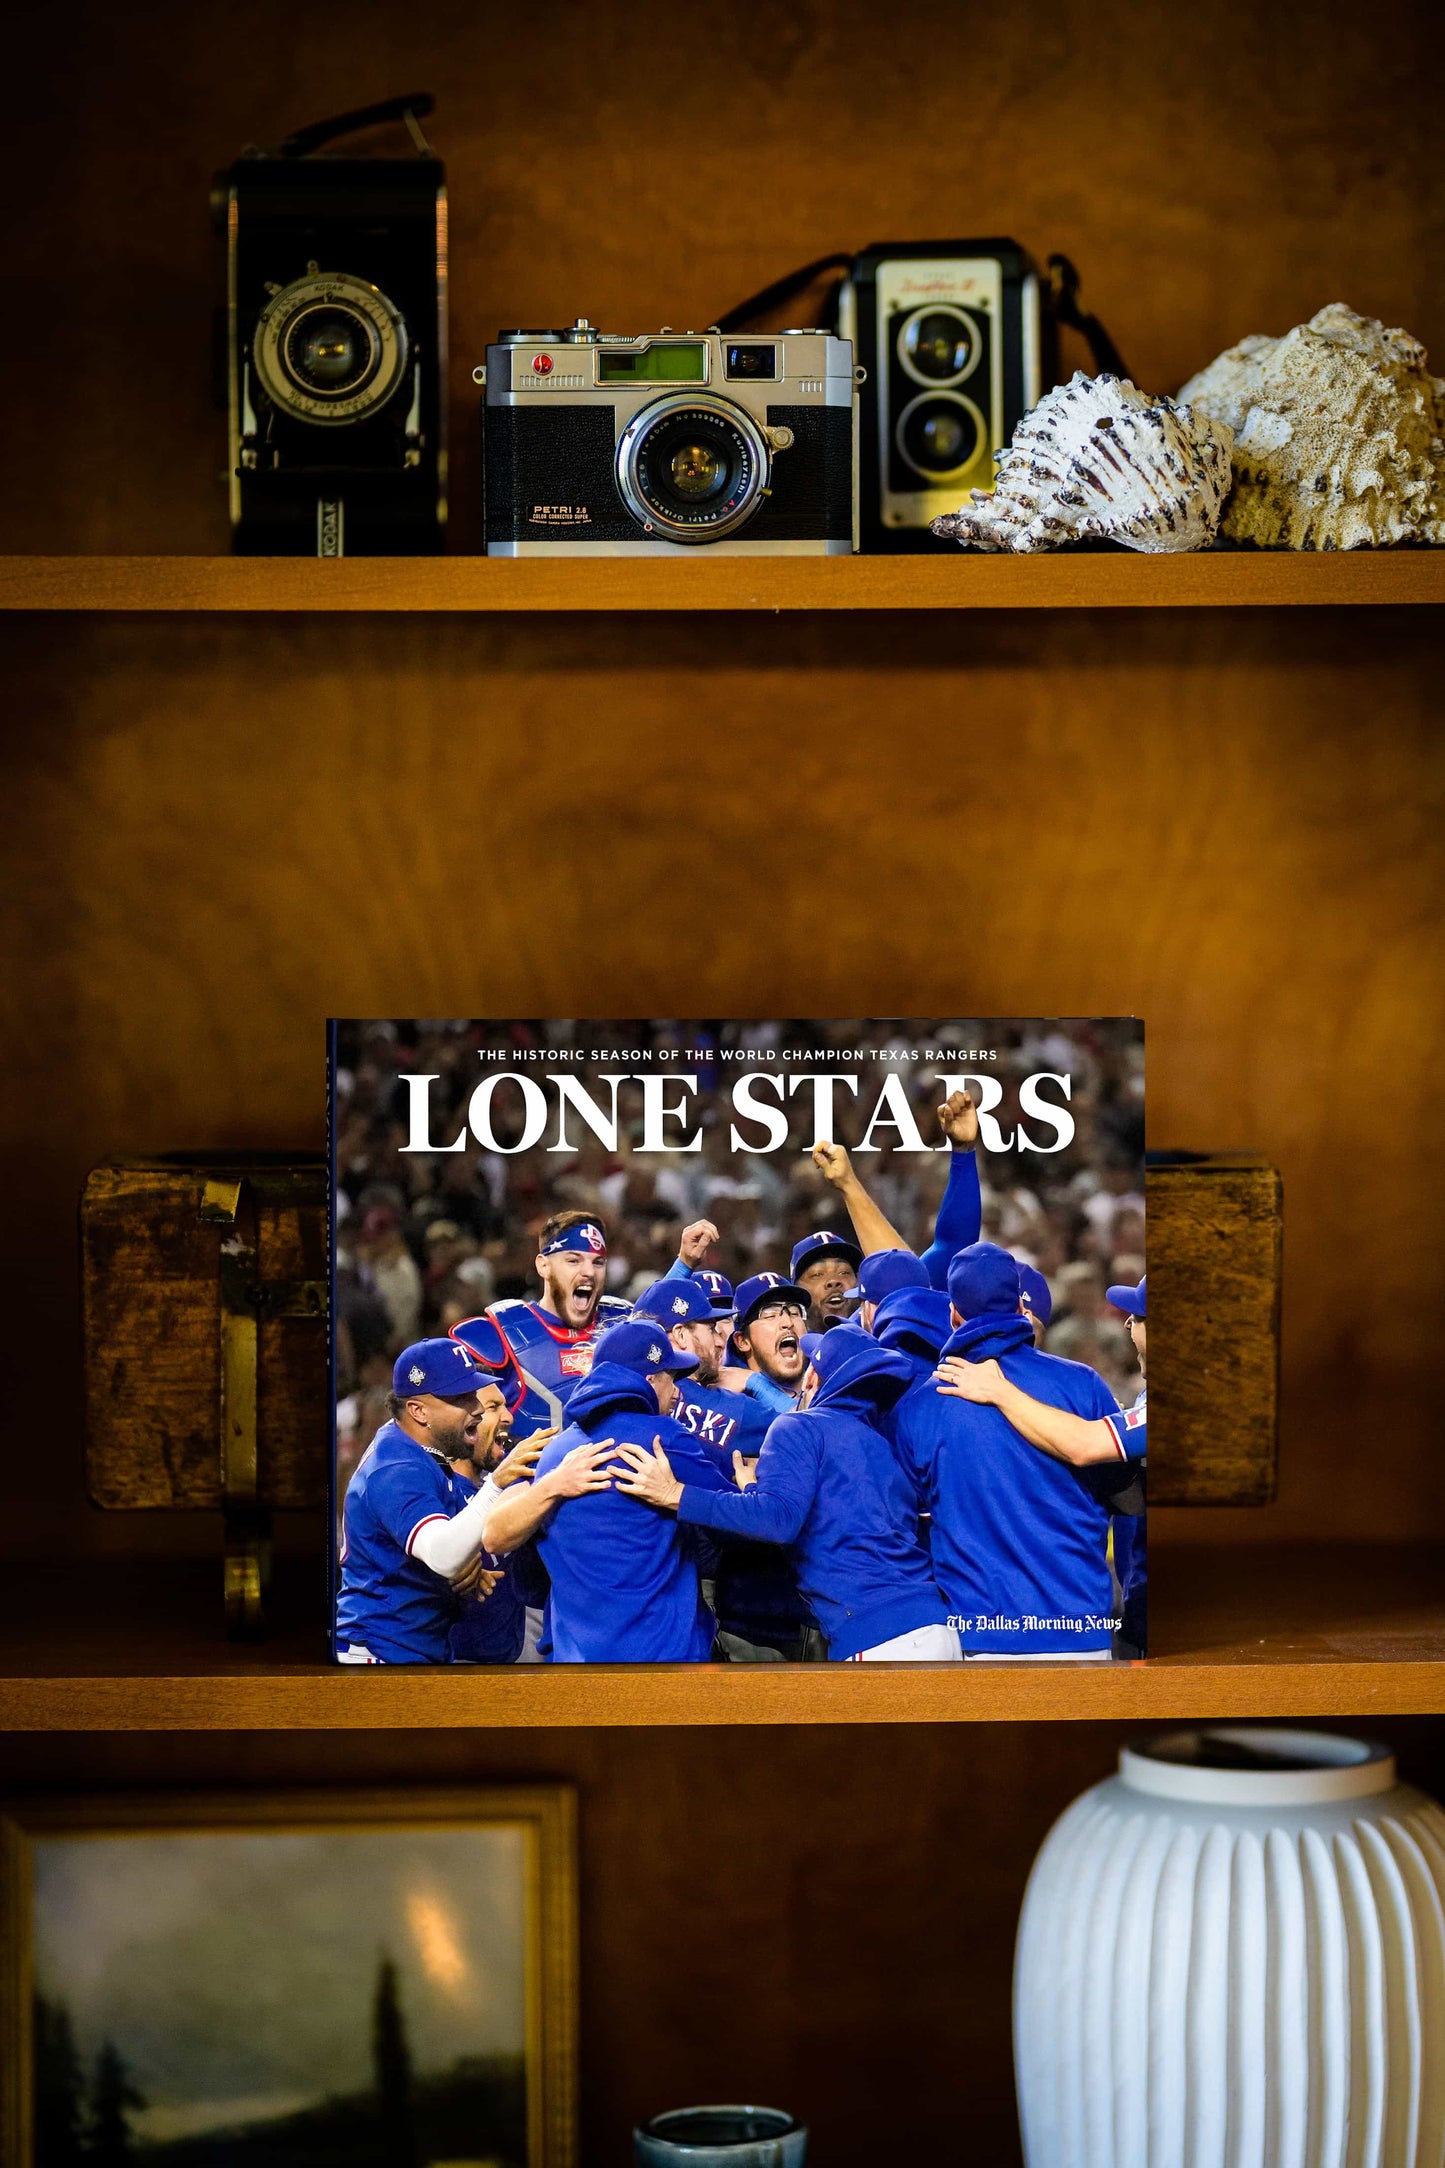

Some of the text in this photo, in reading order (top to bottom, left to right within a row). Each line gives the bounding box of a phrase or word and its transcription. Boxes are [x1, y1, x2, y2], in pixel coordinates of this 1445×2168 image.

[534, 505, 587, 514] PETRI 2.8
[689, 513, 717, 522] Petri
[323, 501, 337, 556] KODAK
[477, 1049, 997, 1061] THE HISTORIC SEASON OF THE WORLD CHAMPION TEXAS RANGERS
[398, 1073, 1075, 1153] LONE STARS
[703, 1273, 723, 1294] T
[758, 1272, 783, 1288] T
[452, 1345, 473, 1368] T
[946, 1615, 1123, 1633] The Dallas Morning News
